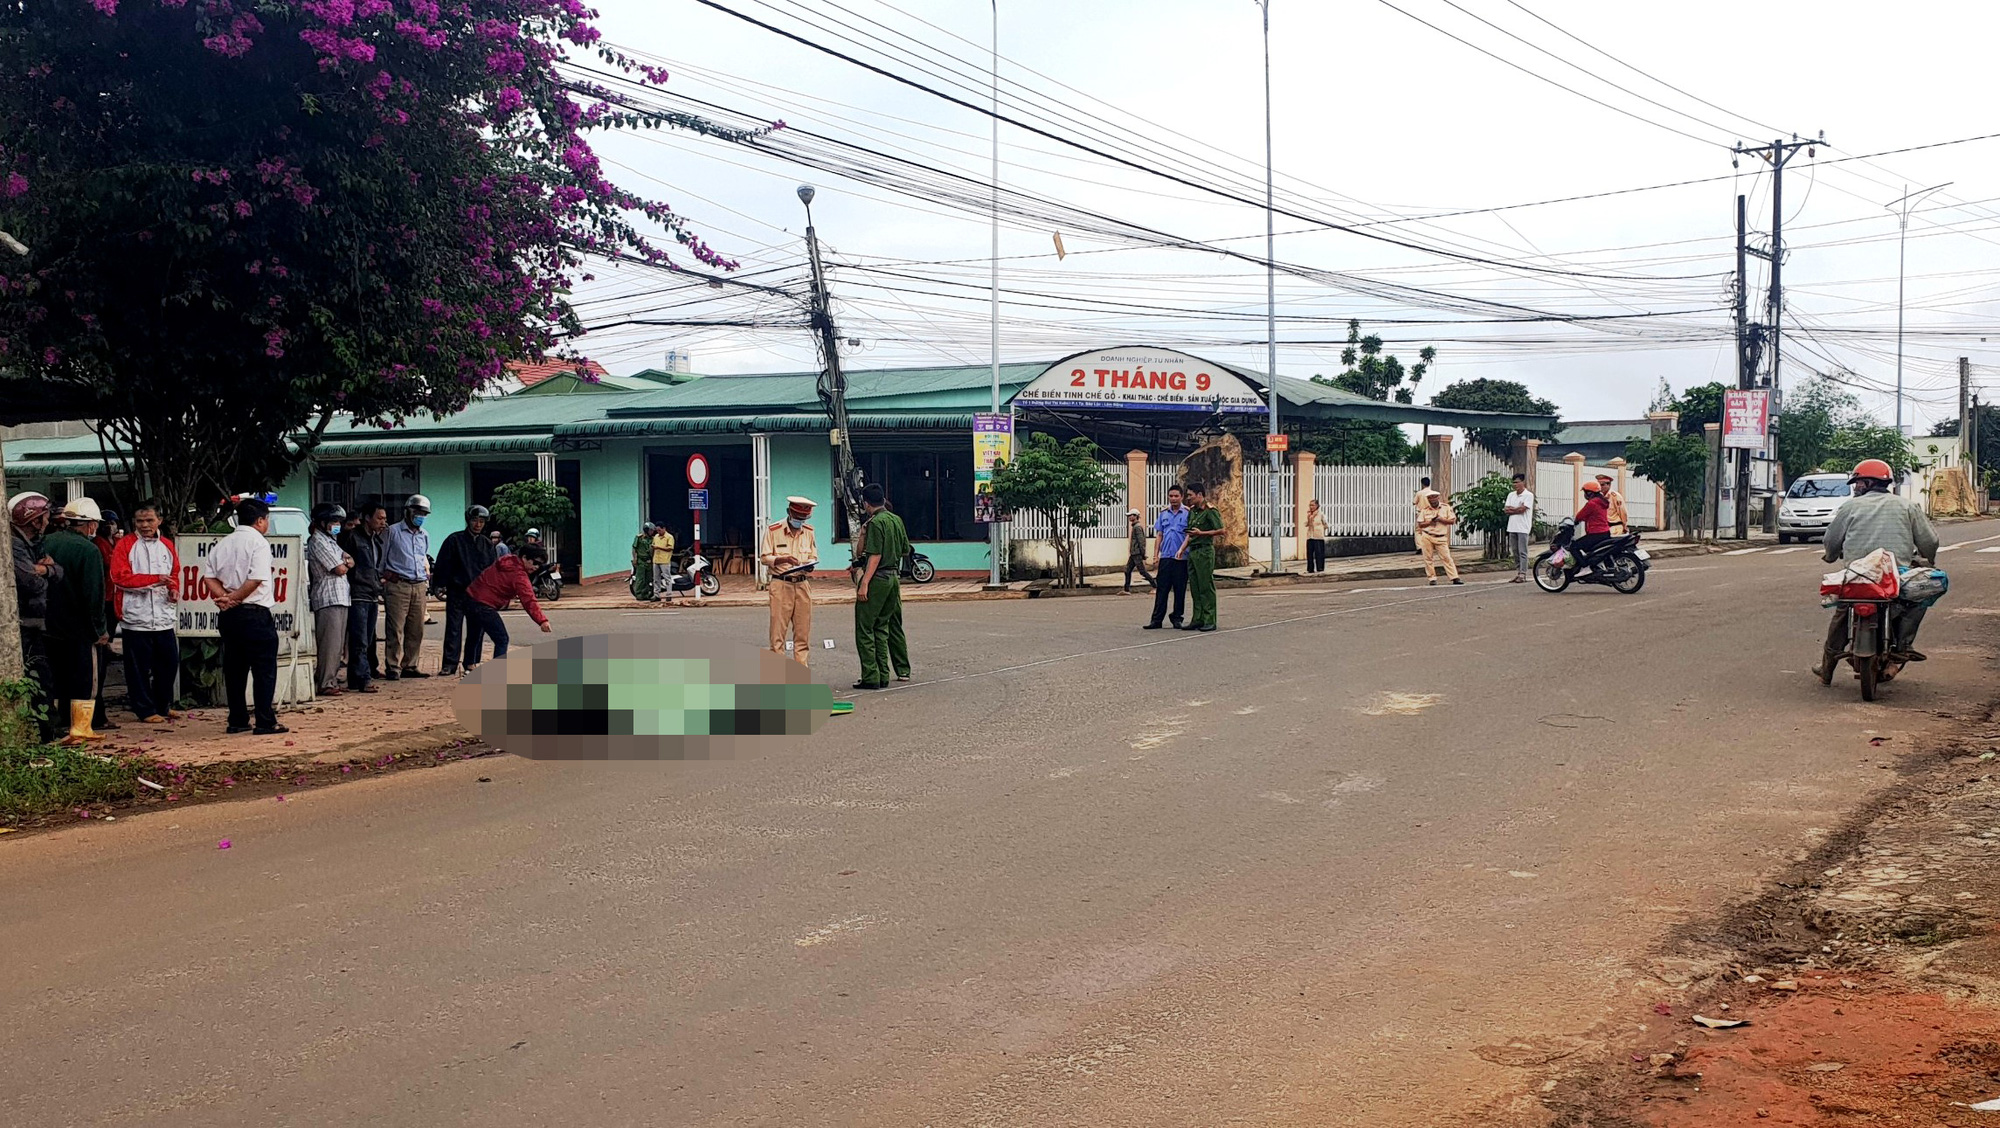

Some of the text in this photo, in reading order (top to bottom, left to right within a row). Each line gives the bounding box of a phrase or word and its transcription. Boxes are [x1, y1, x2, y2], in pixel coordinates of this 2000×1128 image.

[1070, 366, 1211, 391] 2 THÁNG 9
[1022, 388, 1039, 398] CHẾ
[1041, 389, 1061, 398] BIẾN
[1063, 391, 1083, 399] TINH
[1085, 389, 1102, 400] CHẾ
[1138, 392, 1153, 402] THÁC
[1157, 393, 1169, 402] CHẾ
[1170, 393, 1184, 402] BIẾN
[1241, 397, 1257, 405] DỤNG
[271, 544, 288, 558] AM
[179, 607, 293, 633] ĐÀO TẠO HỌ GHIỆP
